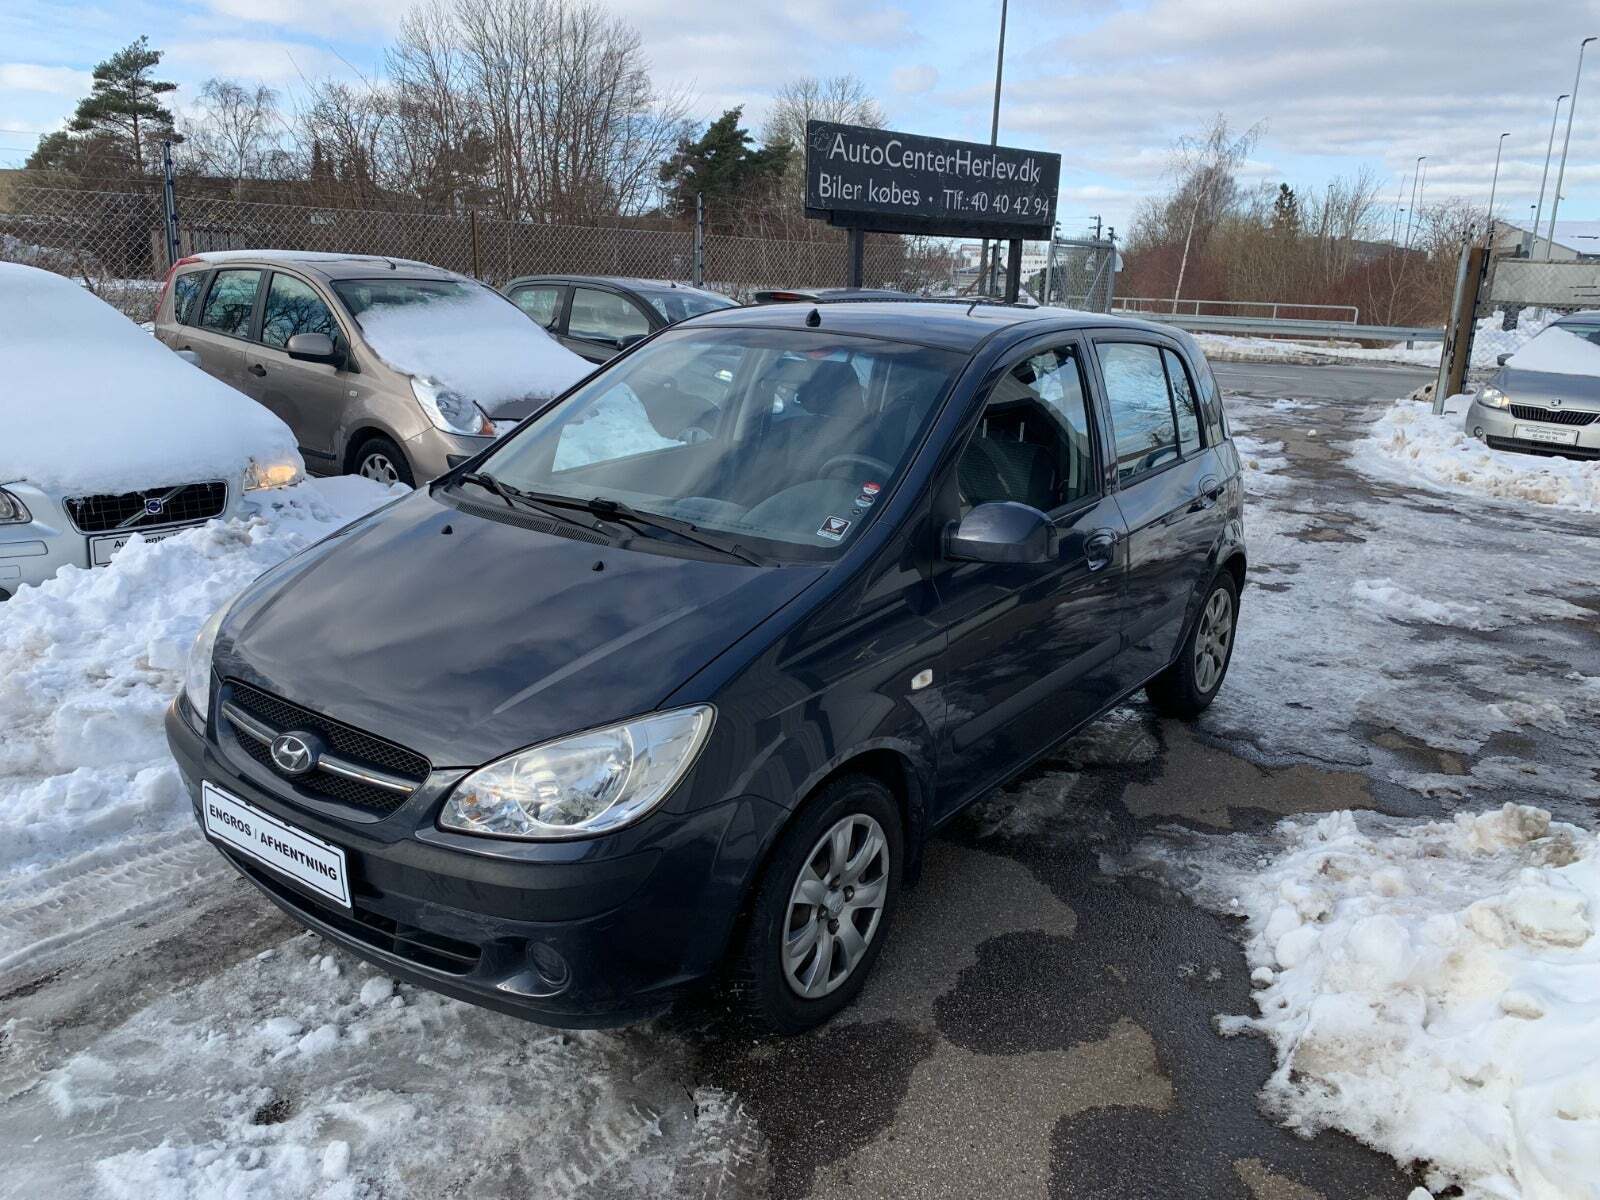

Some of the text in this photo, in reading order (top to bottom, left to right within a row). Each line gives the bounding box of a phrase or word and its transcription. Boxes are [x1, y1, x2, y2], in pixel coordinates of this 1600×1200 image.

[829, 132, 1041, 183] AutoCenterHerlev.dk
[819, 173, 862, 200] Biler
[868, 178, 921, 206] købes
[992, 194, 1010, 214] 40
[1013, 197, 1029, 215] 42
[1034, 197, 1049, 217] 94
[209, 803, 338, 881] ENGROS AFHENTNING
